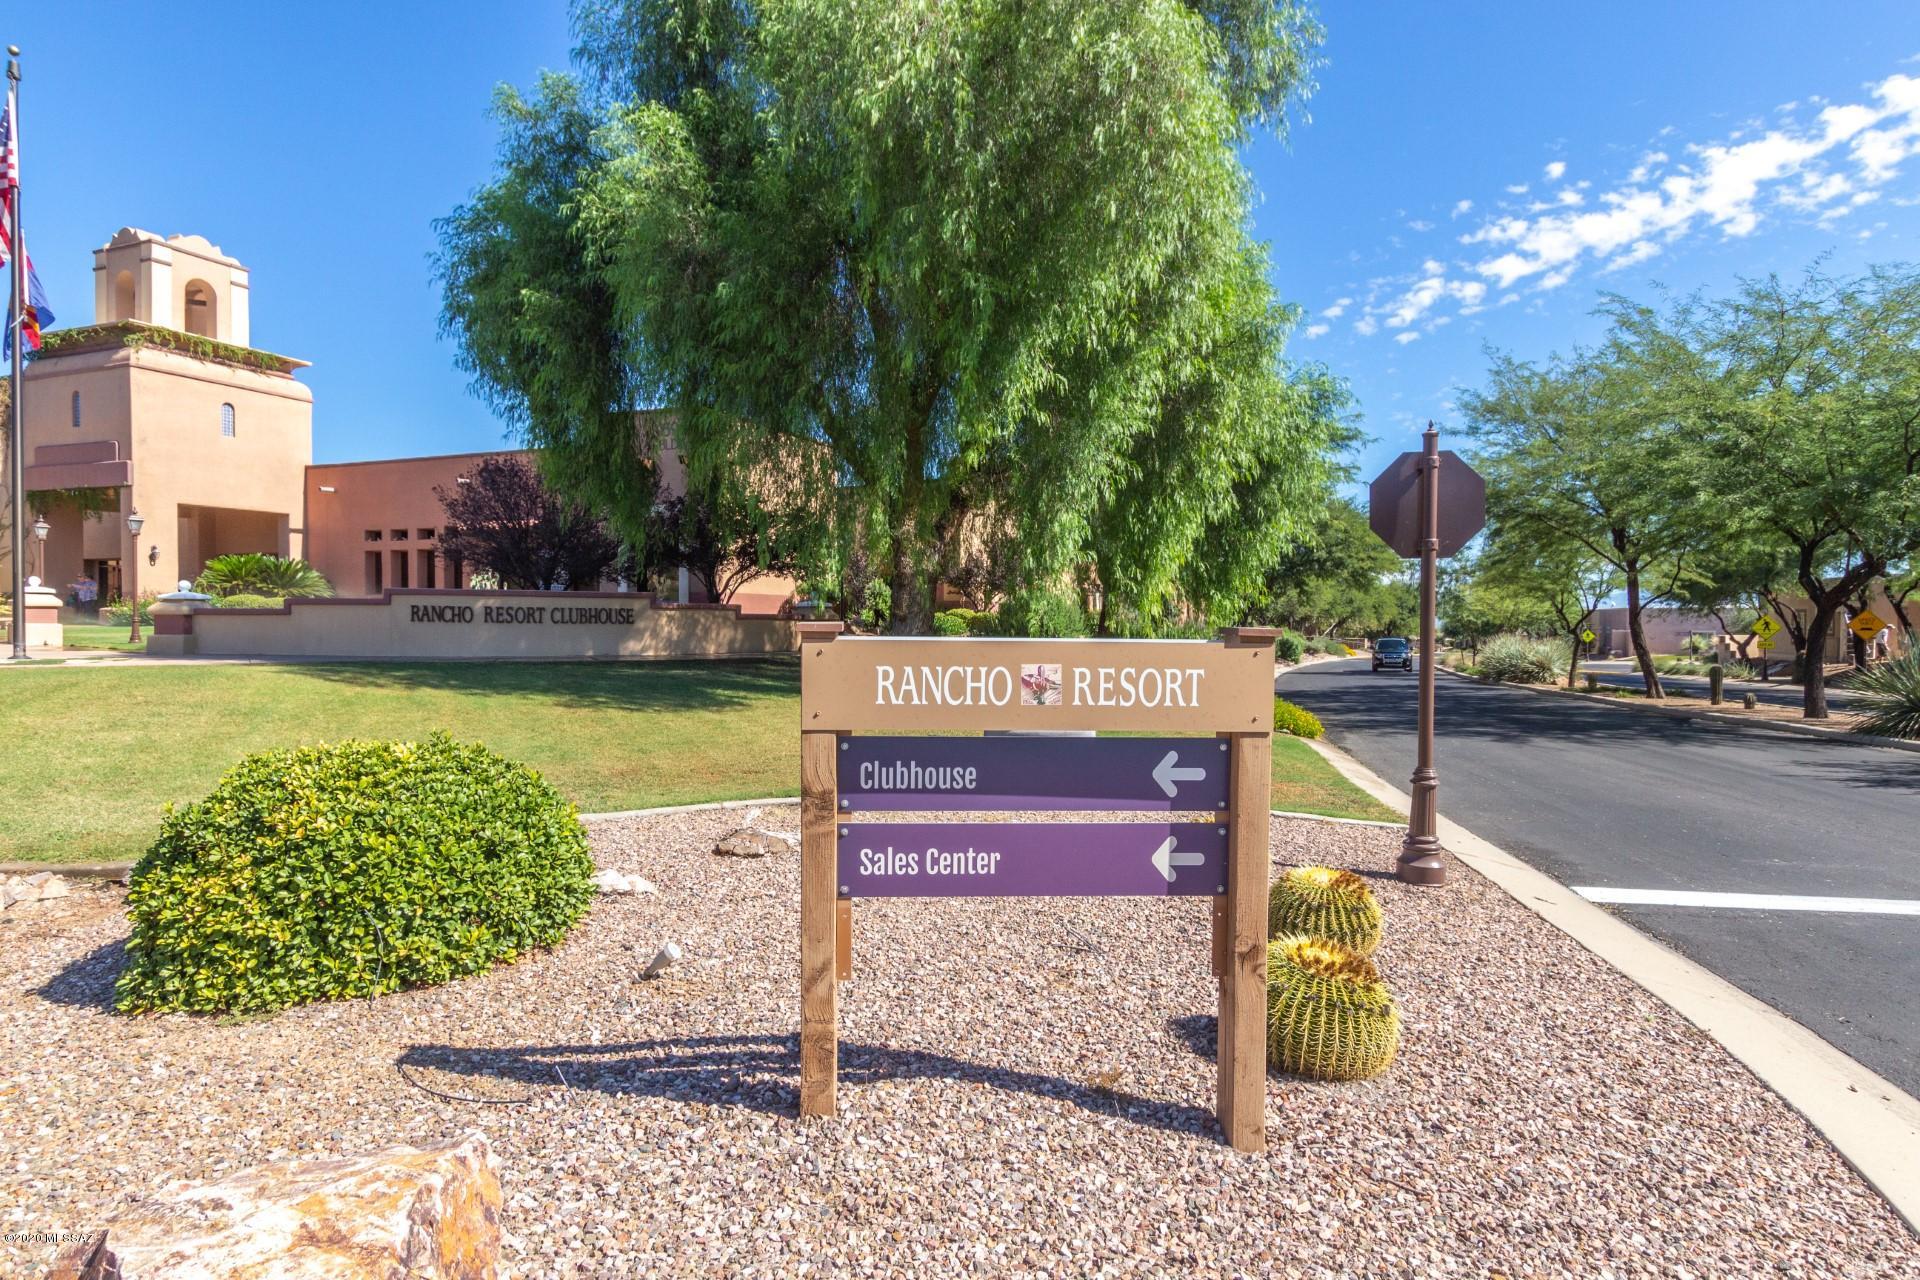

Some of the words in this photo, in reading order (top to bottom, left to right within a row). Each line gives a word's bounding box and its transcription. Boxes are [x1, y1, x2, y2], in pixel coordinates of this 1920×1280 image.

[410, 604, 474, 623] RANCHO
[484, 606, 546, 624] RESORT
[551, 608, 636, 625] CLUBHOUSE
[875, 665, 1013, 706] RANCHO
[1071, 667, 1205, 707] RESORT
[860, 760, 977, 790] Clubhouse
[859, 846, 919, 876] Sales
[925, 847, 1001, 876] Center
